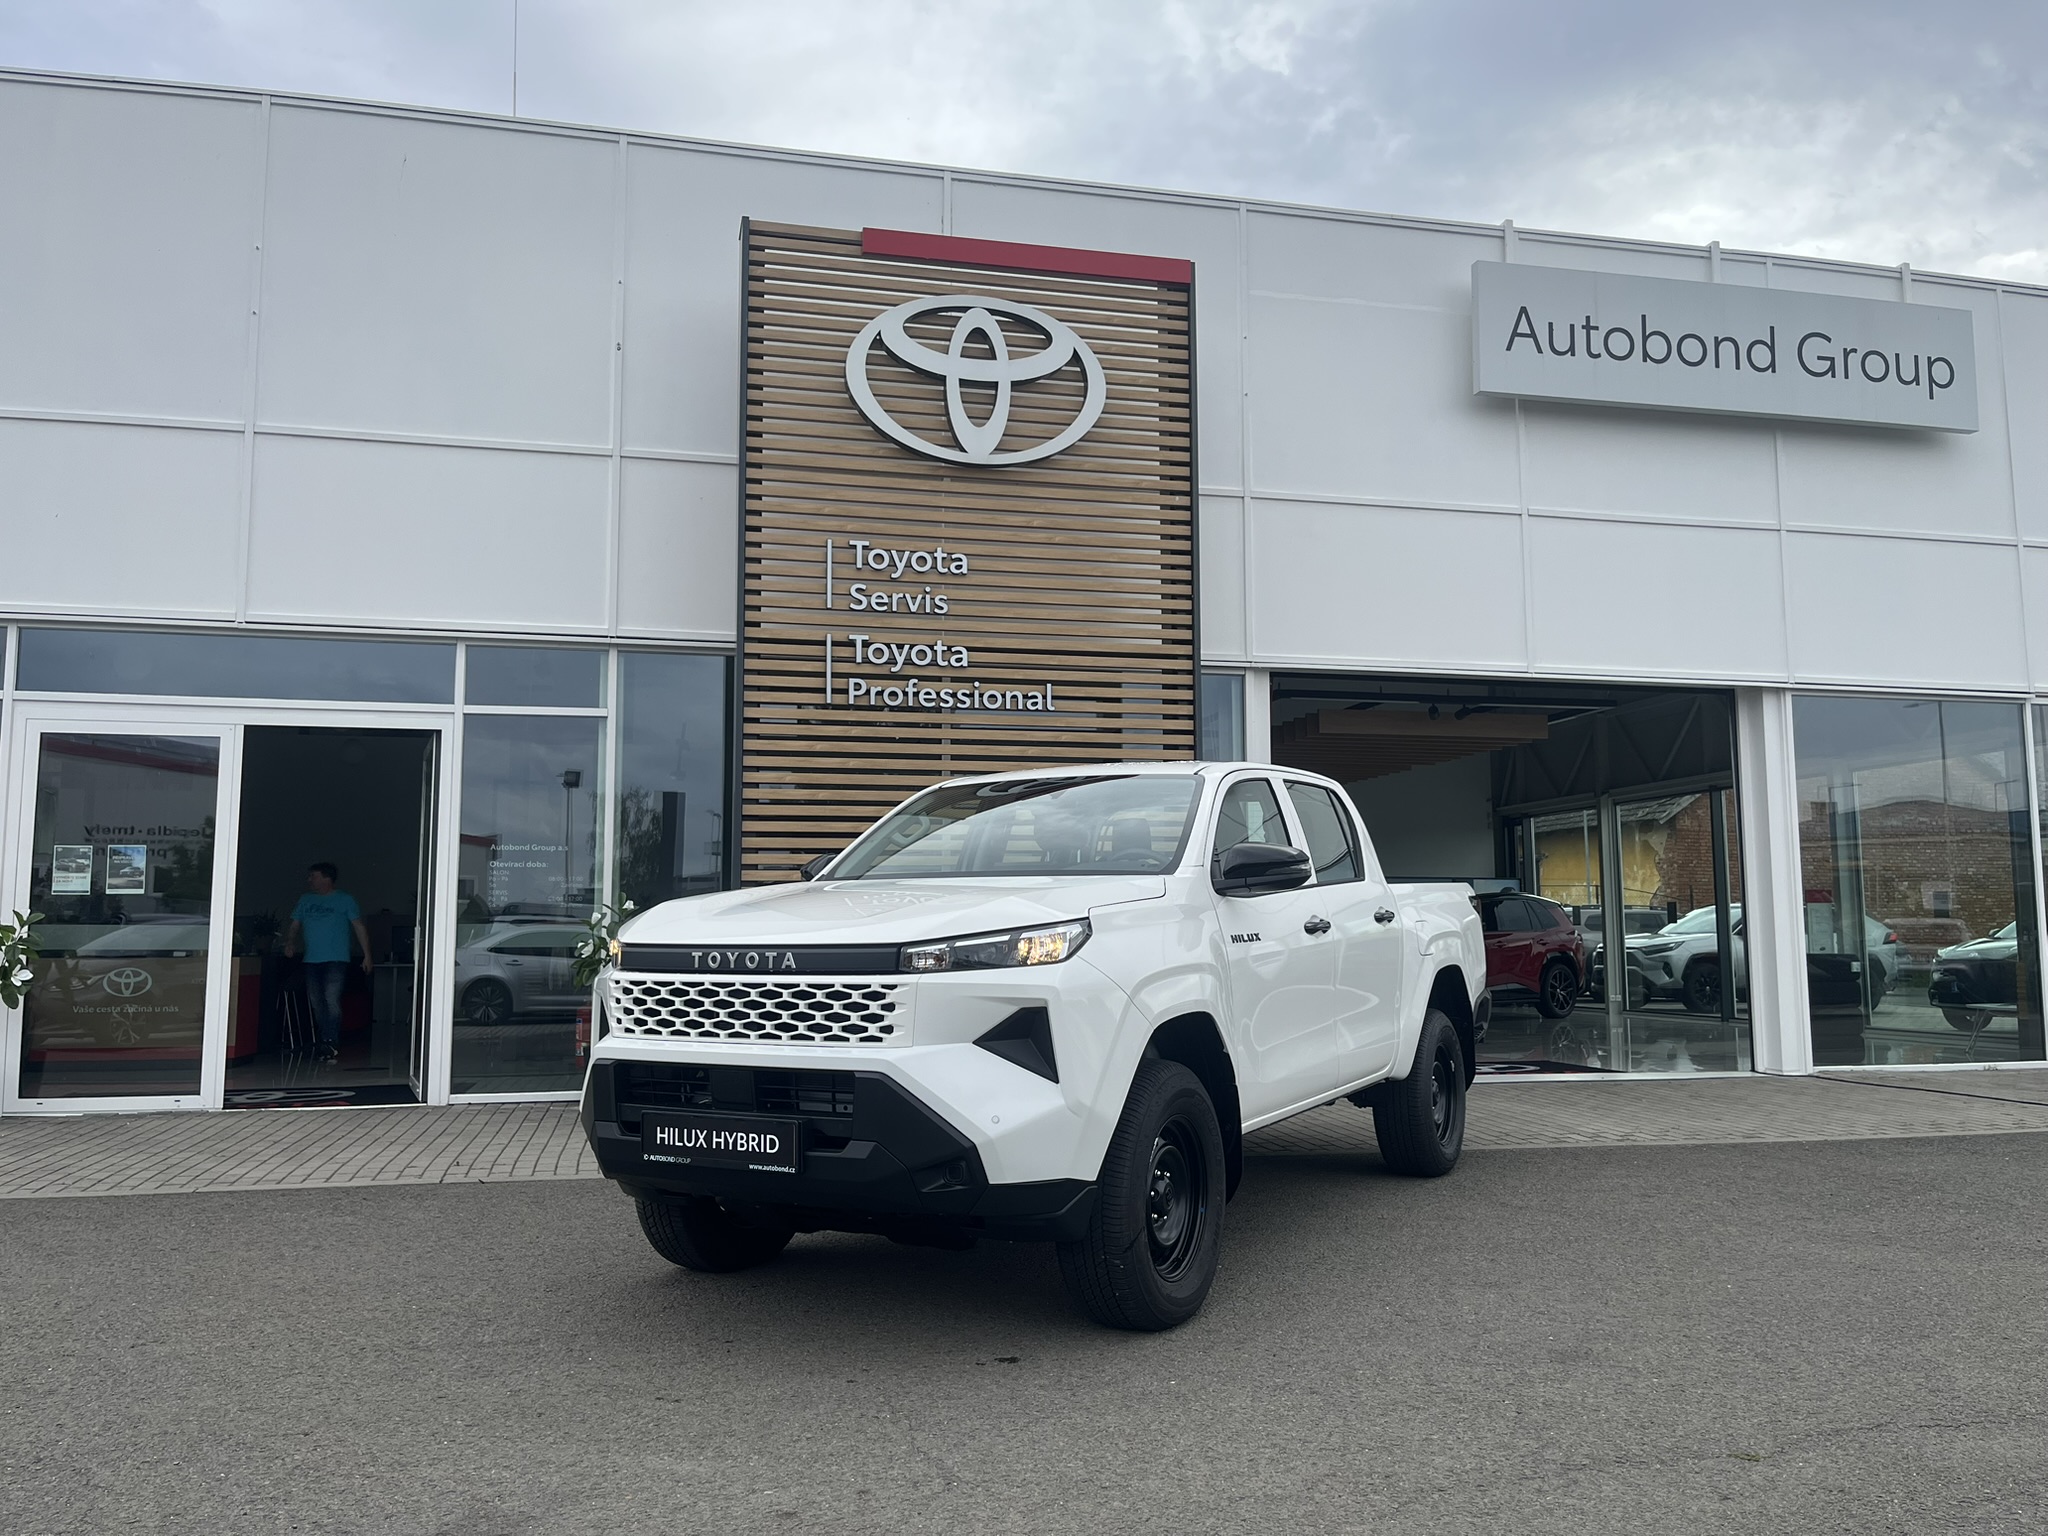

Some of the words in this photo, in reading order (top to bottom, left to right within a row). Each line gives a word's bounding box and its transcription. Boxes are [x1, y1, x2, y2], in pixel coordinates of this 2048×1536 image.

[1505, 305, 1777, 374] Autobond
[1796, 331, 1956, 400] Group
[848, 539, 969, 577] Toyota
[848, 582, 949, 615] Servis
[847, 634, 969, 671] Toyota
[847, 677, 1056, 712] Professional
[490, 843, 530, 851] Autobond
[531, 843, 557, 853] Group
[489, 860, 525, 868] Otevírací
[526, 860, 549, 868] doba:
[1230, 932, 1262, 944] HILUX
[691, 951, 797, 969] TOYOTA
[72, 1004, 95, 1013] Vaše
[96, 1005, 121, 1013] cesta
[162, 1004, 179, 1013] nás
[655, 1125, 708, 1149] HILUX
[712, 1129, 780, 1154] HYBRID
[649, 1154, 676, 1163] AUTOBOND
[676, 1156, 692, 1164] GROUP
[748, 1163, 796, 1174] www.autobond.cz
